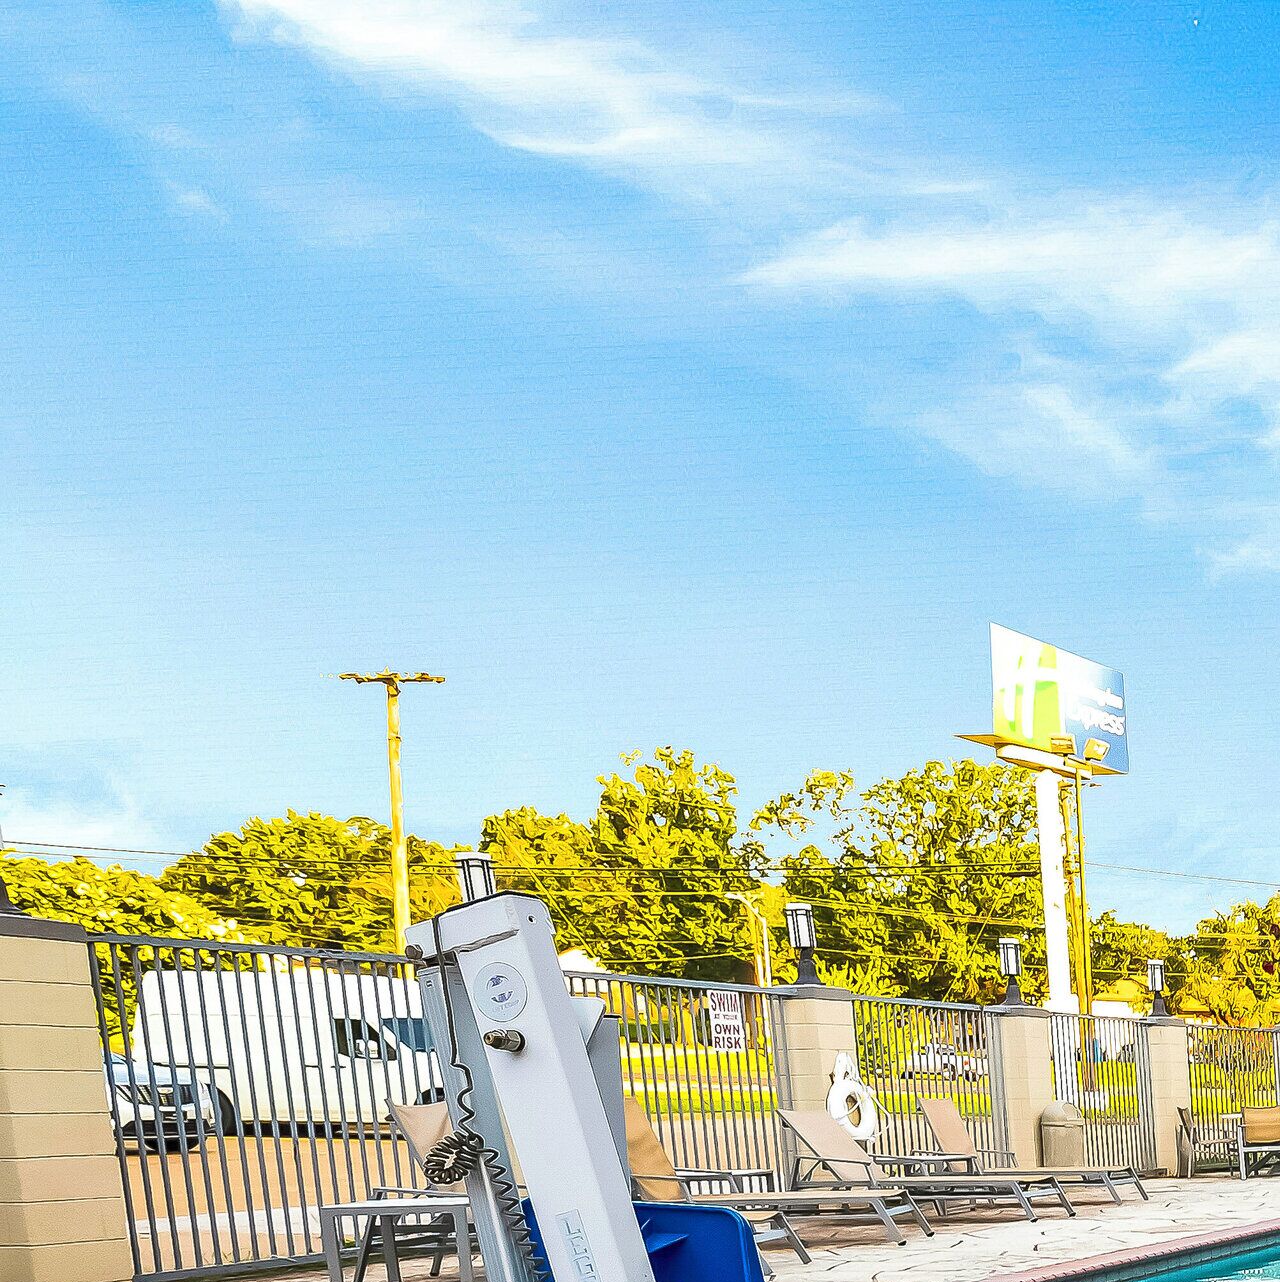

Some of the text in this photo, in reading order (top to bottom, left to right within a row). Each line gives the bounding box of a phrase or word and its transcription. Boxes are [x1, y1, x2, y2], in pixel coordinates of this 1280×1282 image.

[710, 992, 738, 1012] SWIM
[714, 1023, 740, 1035] OWN
[714, 1036, 741, 1049] RISK
